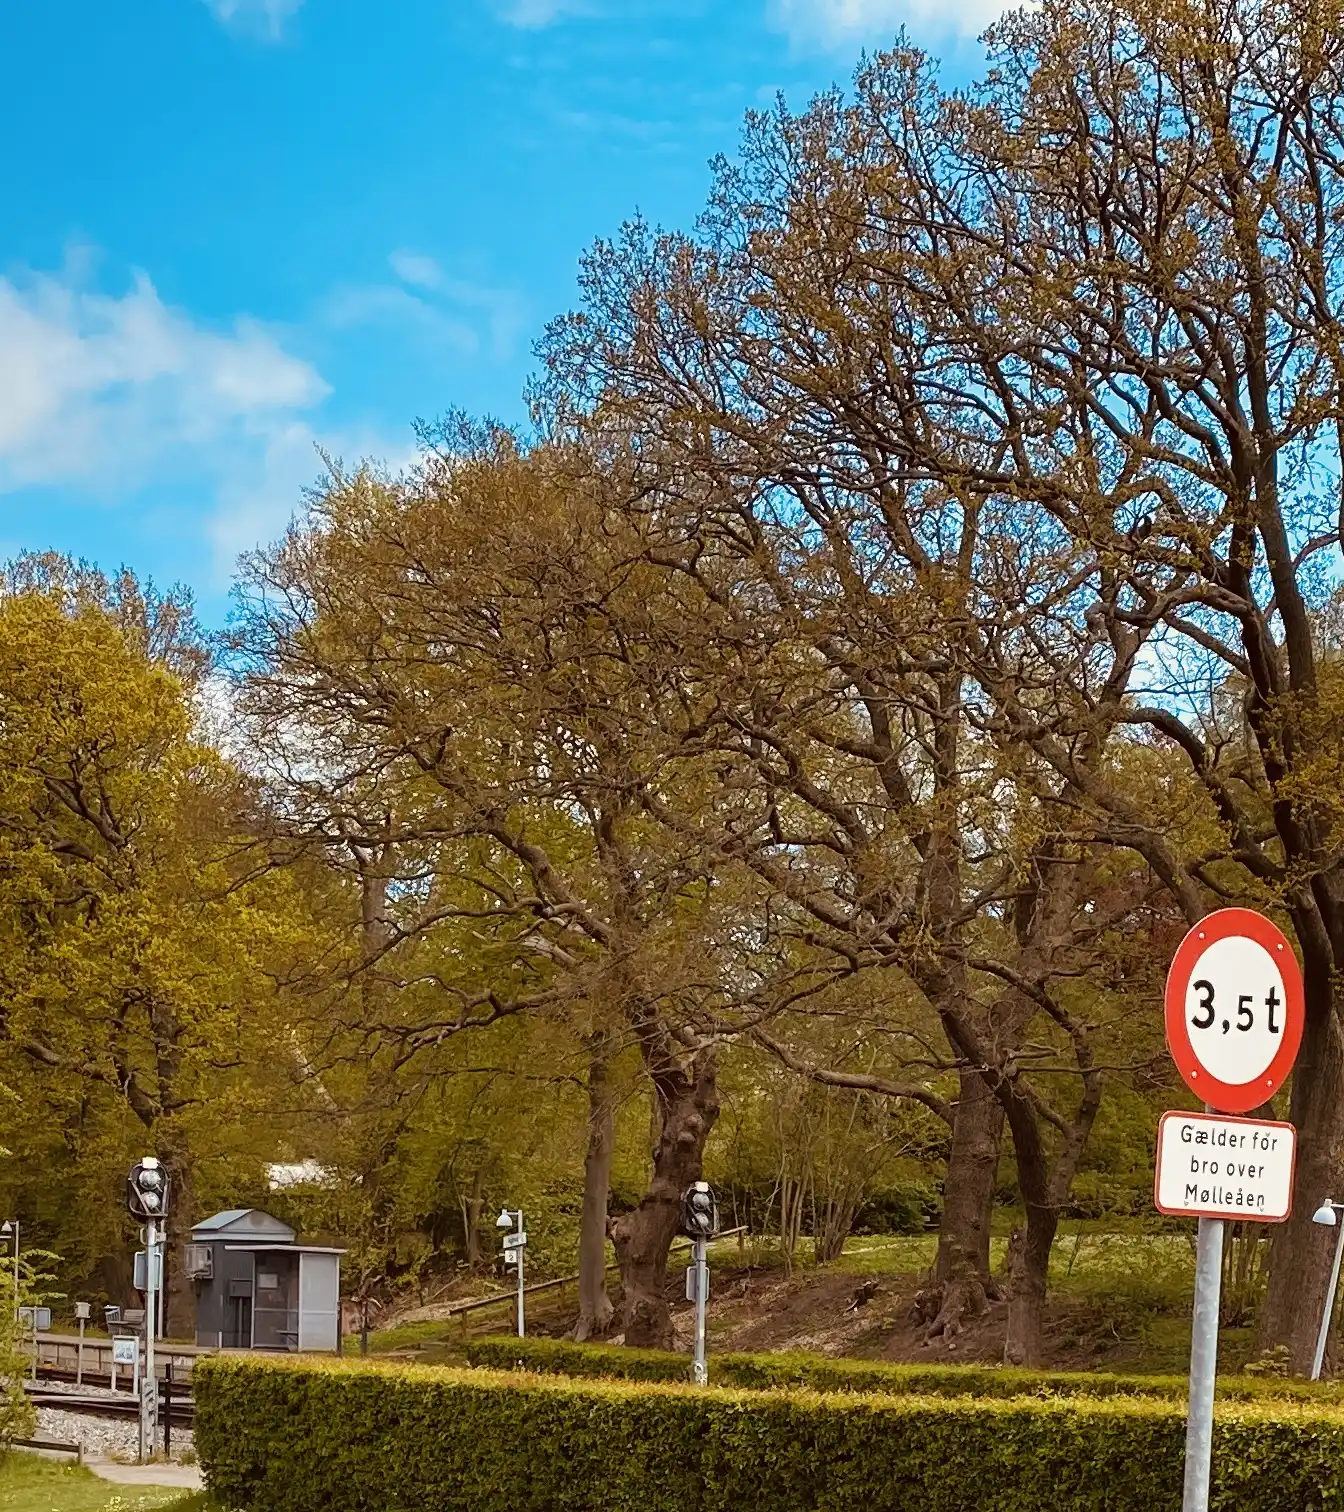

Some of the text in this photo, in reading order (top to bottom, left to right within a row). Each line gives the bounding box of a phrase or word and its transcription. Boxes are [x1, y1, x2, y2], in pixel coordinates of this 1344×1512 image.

[1191, 979, 1281, 1035] 3,5 t
[1180, 1124, 1278, 1152] Gælder for
[1190, 1155, 1265, 1179] bro over
[1184, 1183, 1265, 1208] Mølleåen
